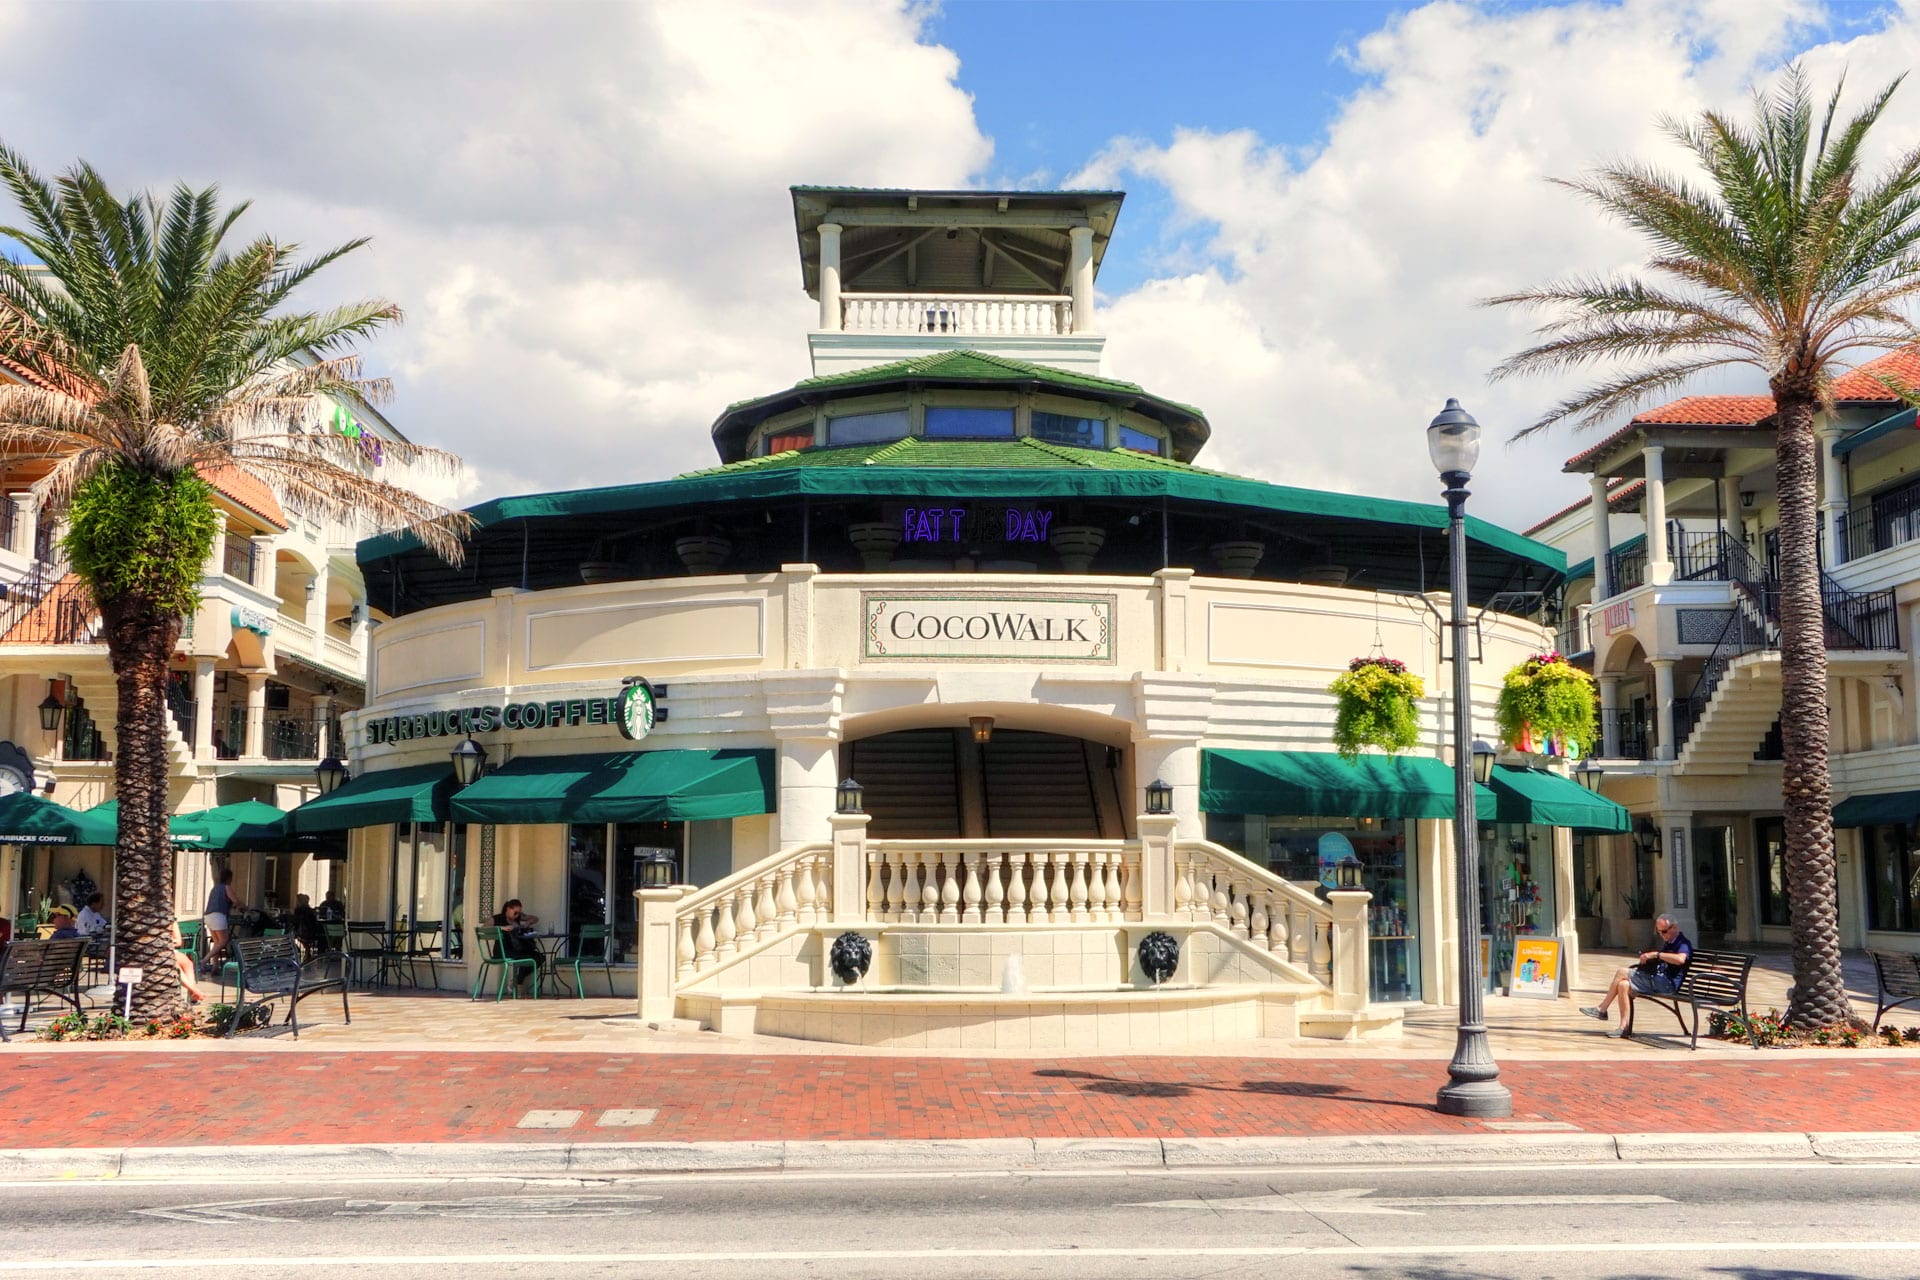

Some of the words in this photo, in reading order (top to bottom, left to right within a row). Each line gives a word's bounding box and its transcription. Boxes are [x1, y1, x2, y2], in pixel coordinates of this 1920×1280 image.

[905, 508, 945, 542] FAT
[365, 705, 496, 745] STARBUCKS
[502, 698, 618, 730] COFFEE
